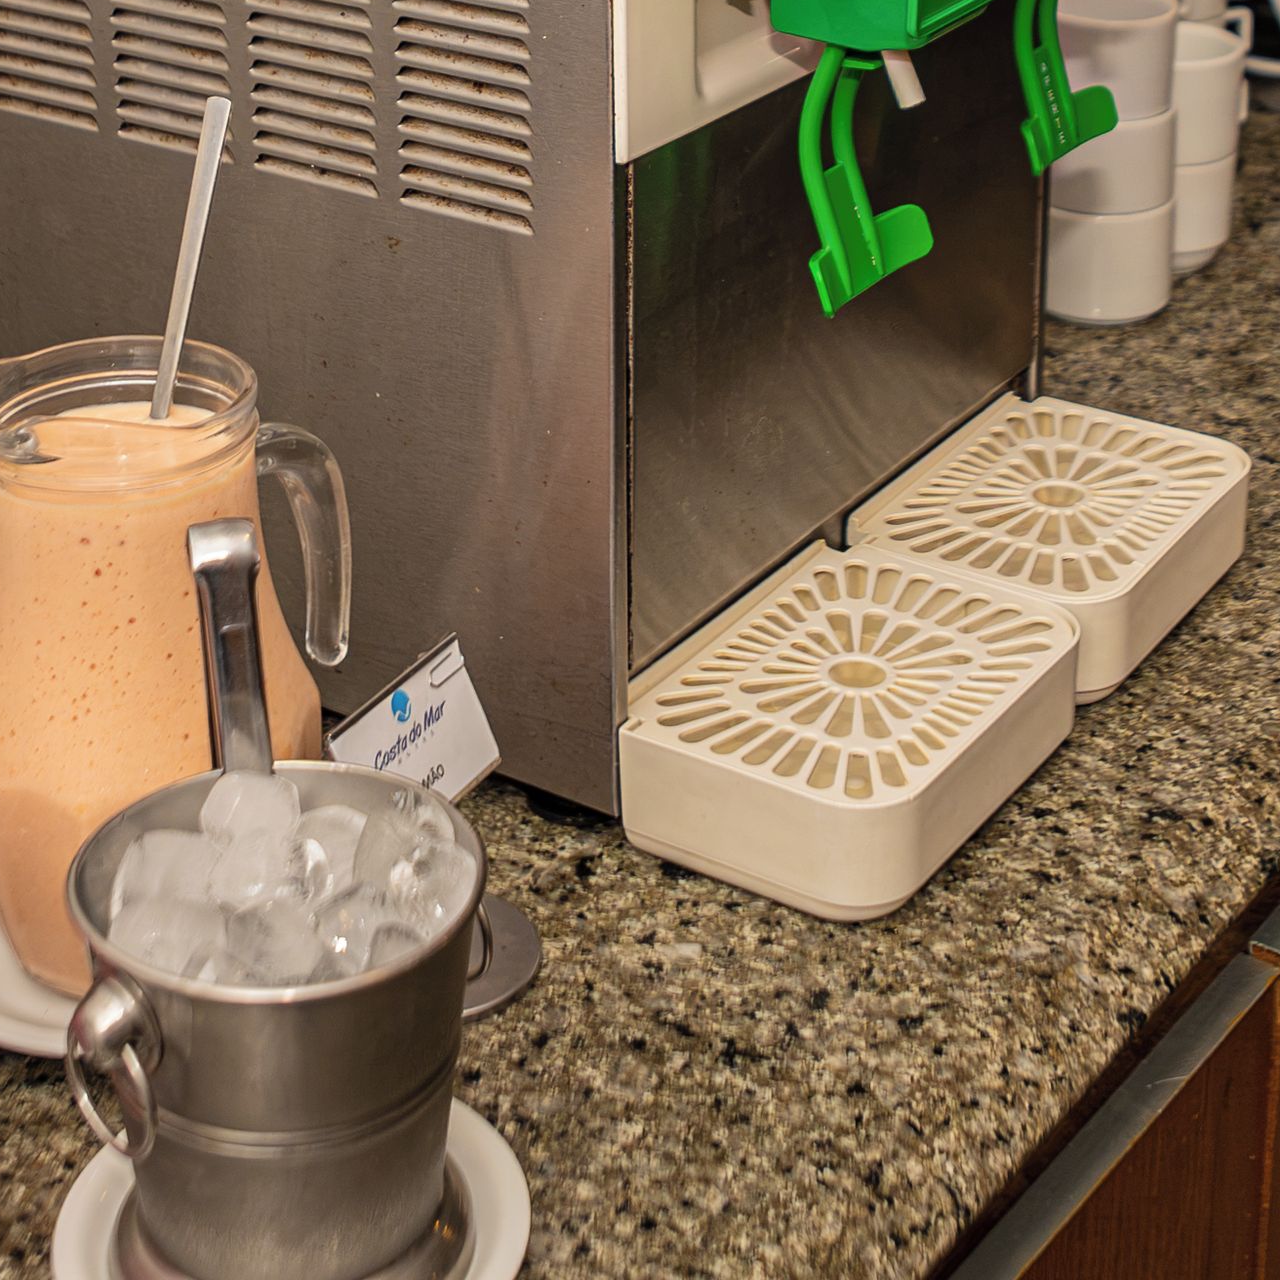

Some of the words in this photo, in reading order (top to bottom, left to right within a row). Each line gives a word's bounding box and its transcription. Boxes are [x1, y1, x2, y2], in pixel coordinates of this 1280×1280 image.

[374, 733, 408, 771] Costa
[409, 720, 422, 744] do
[423, 700, 446, 731] Mar
[421, 763, 445, 790] MÃO
